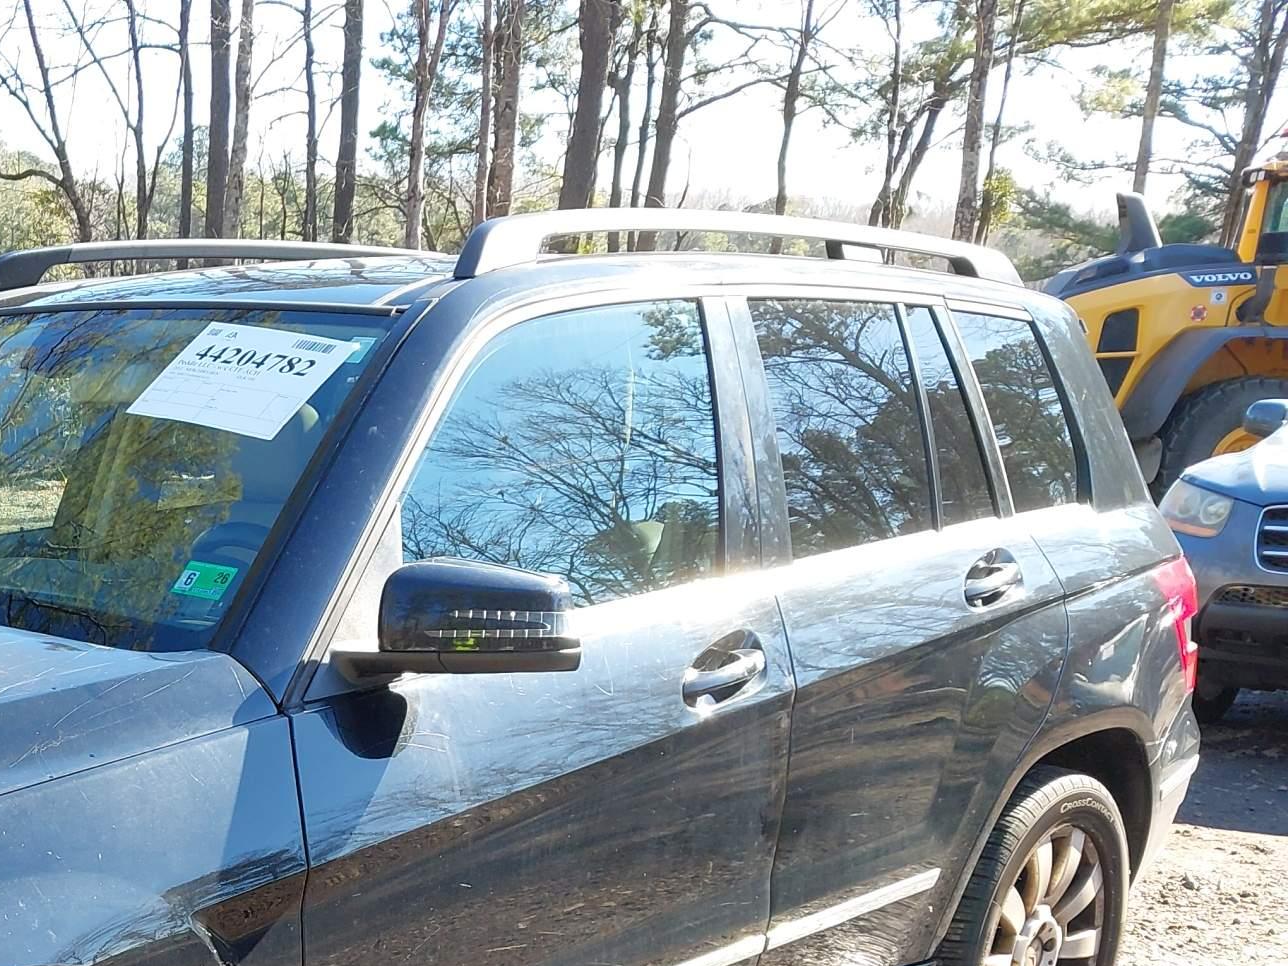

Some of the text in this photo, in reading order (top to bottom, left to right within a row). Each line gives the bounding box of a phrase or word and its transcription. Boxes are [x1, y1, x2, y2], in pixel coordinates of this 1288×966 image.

[1189, 271, 1253, 283] VOLVO
[195, 344, 317, 377] 44204782
[183, 572, 197, 586] 6
[214, 571, 231, 585] 26
